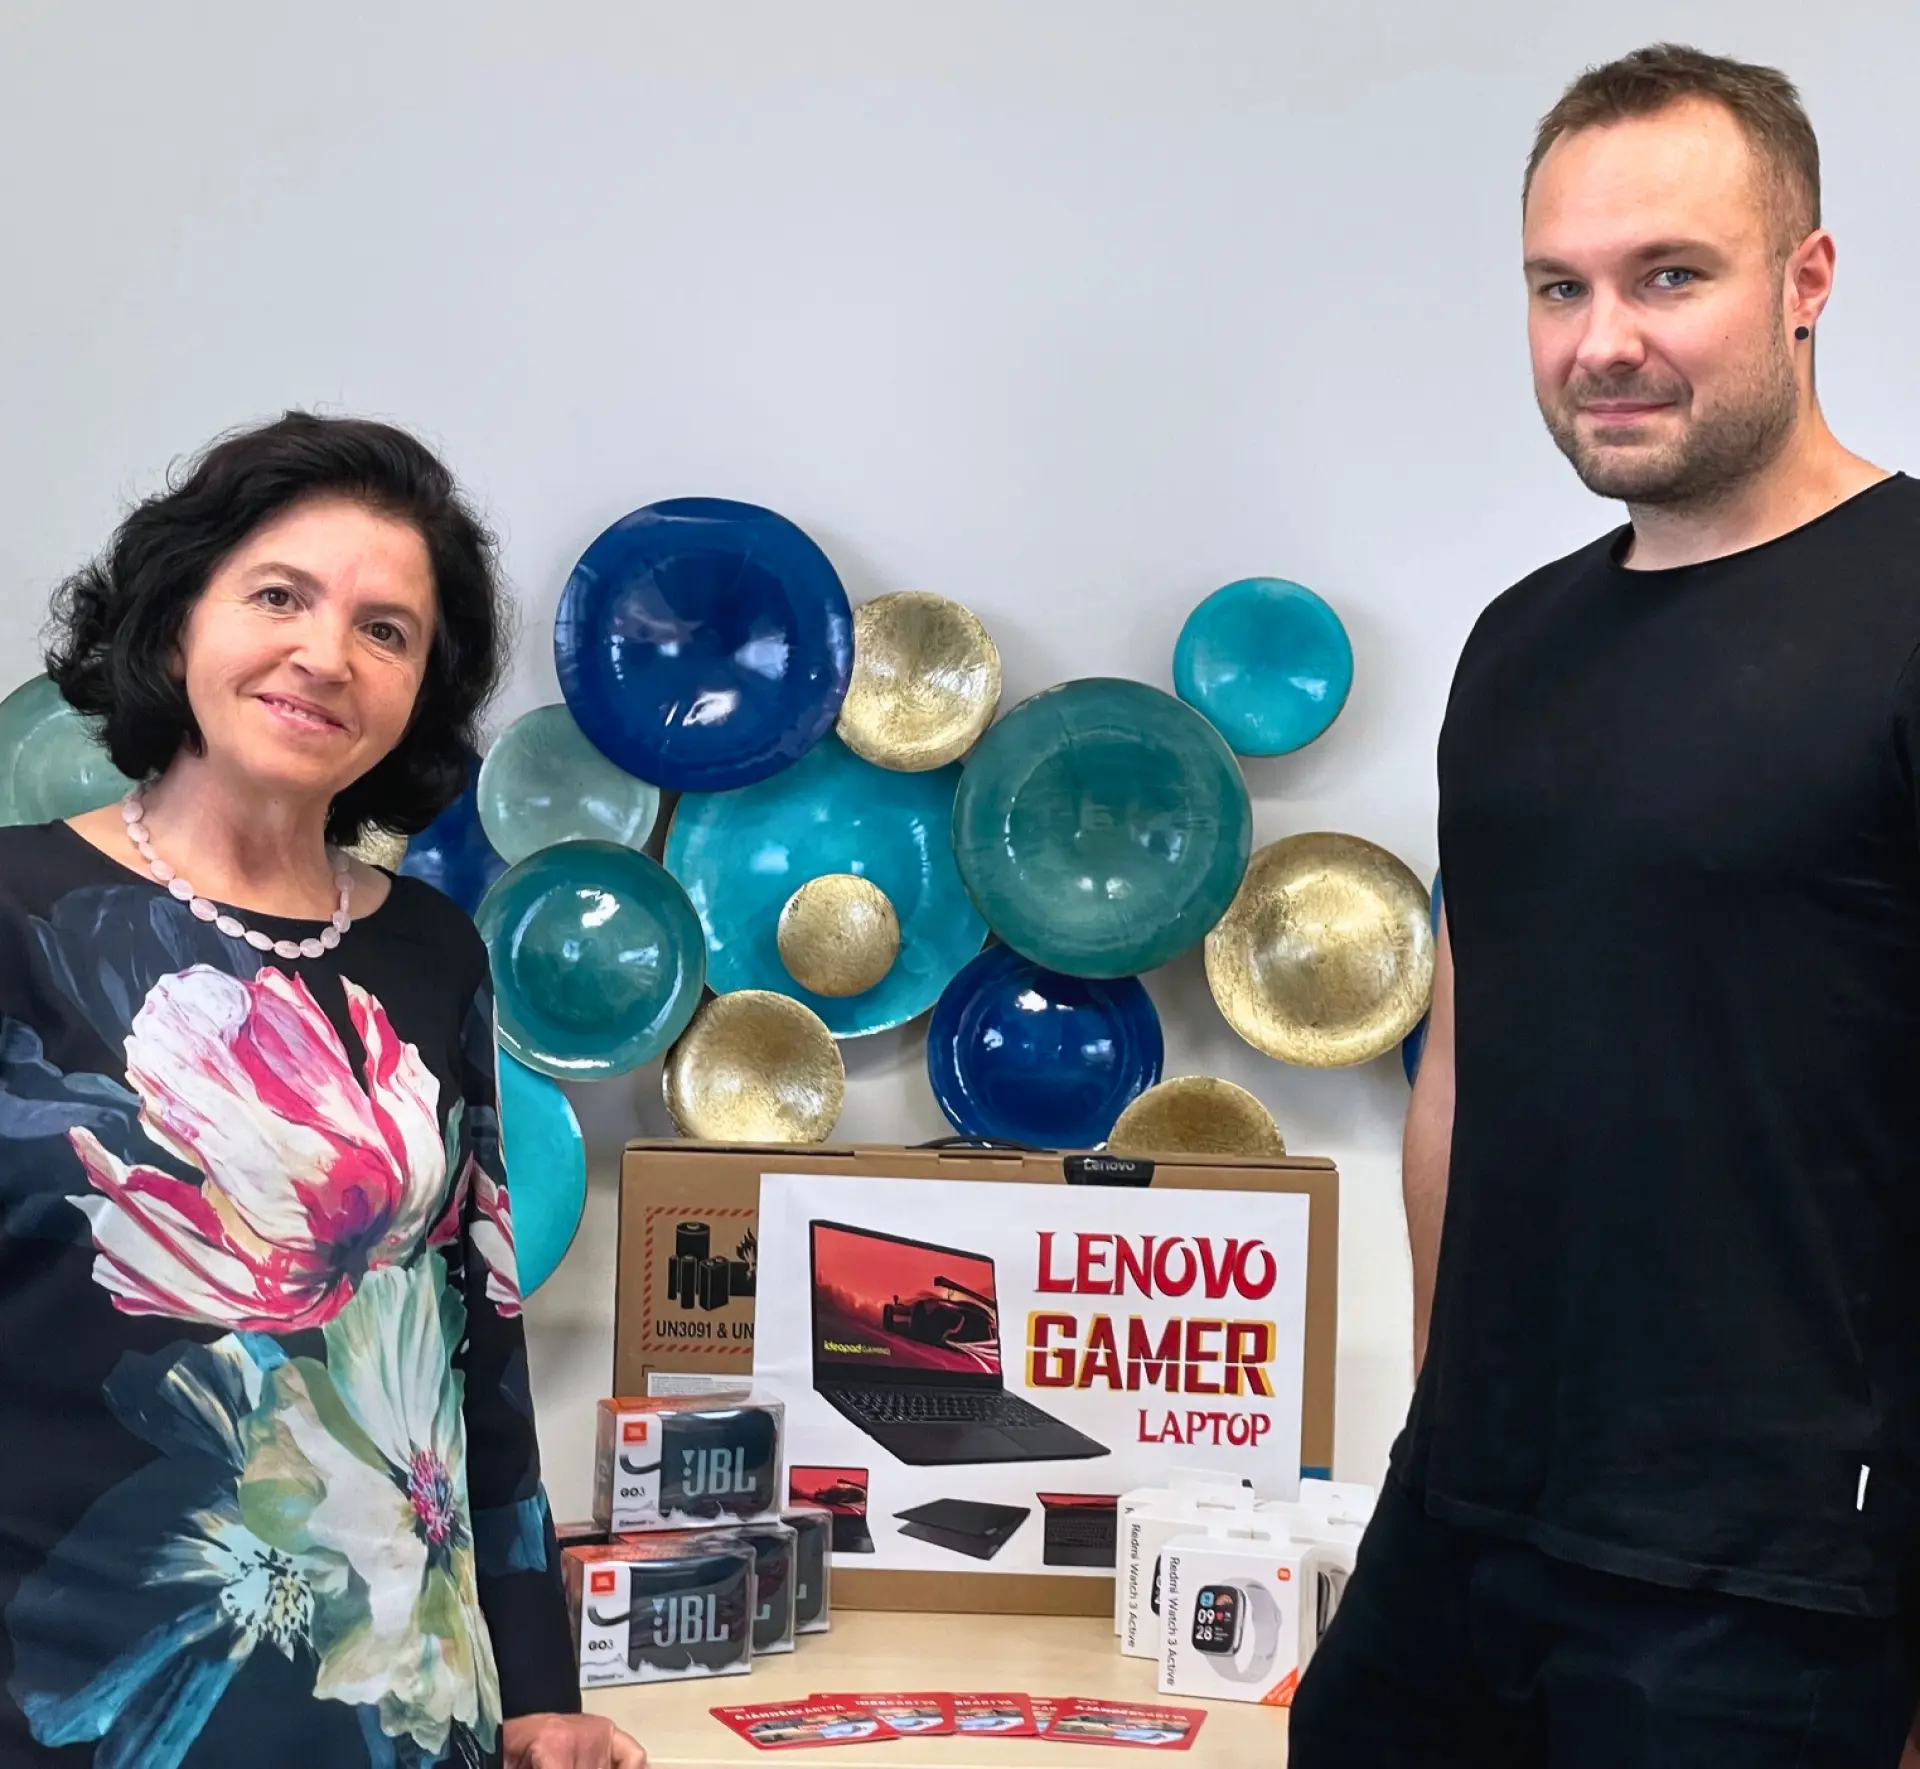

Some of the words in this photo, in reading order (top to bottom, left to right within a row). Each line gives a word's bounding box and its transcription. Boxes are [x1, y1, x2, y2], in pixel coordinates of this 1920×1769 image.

[1083, 1157, 1136, 1171] Lenovo
[1034, 1230, 1278, 1300] LENOVO
[656, 1319, 712, 1338] UN3091
[716, 1322, 728, 1339] &
[1025, 1310, 1278, 1398] GAMER
[1137, 1408, 1272, 1447] LAPTOP
[682, 1446, 757, 1497] JBL
[1130, 1523, 1142, 1559] Redmi
[1129, 1563, 1141, 1600] Watch
[1168, 1556, 1181, 1593] Redmi
[652, 1594, 730, 1648] JBL
[1127, 1612, 1138, 1648] Active
[1167, 1598, 1179, 1636] Watch
[1167, 1639, 1177, 1647] 3
[1166, 1648, 1177, 1686] Active
